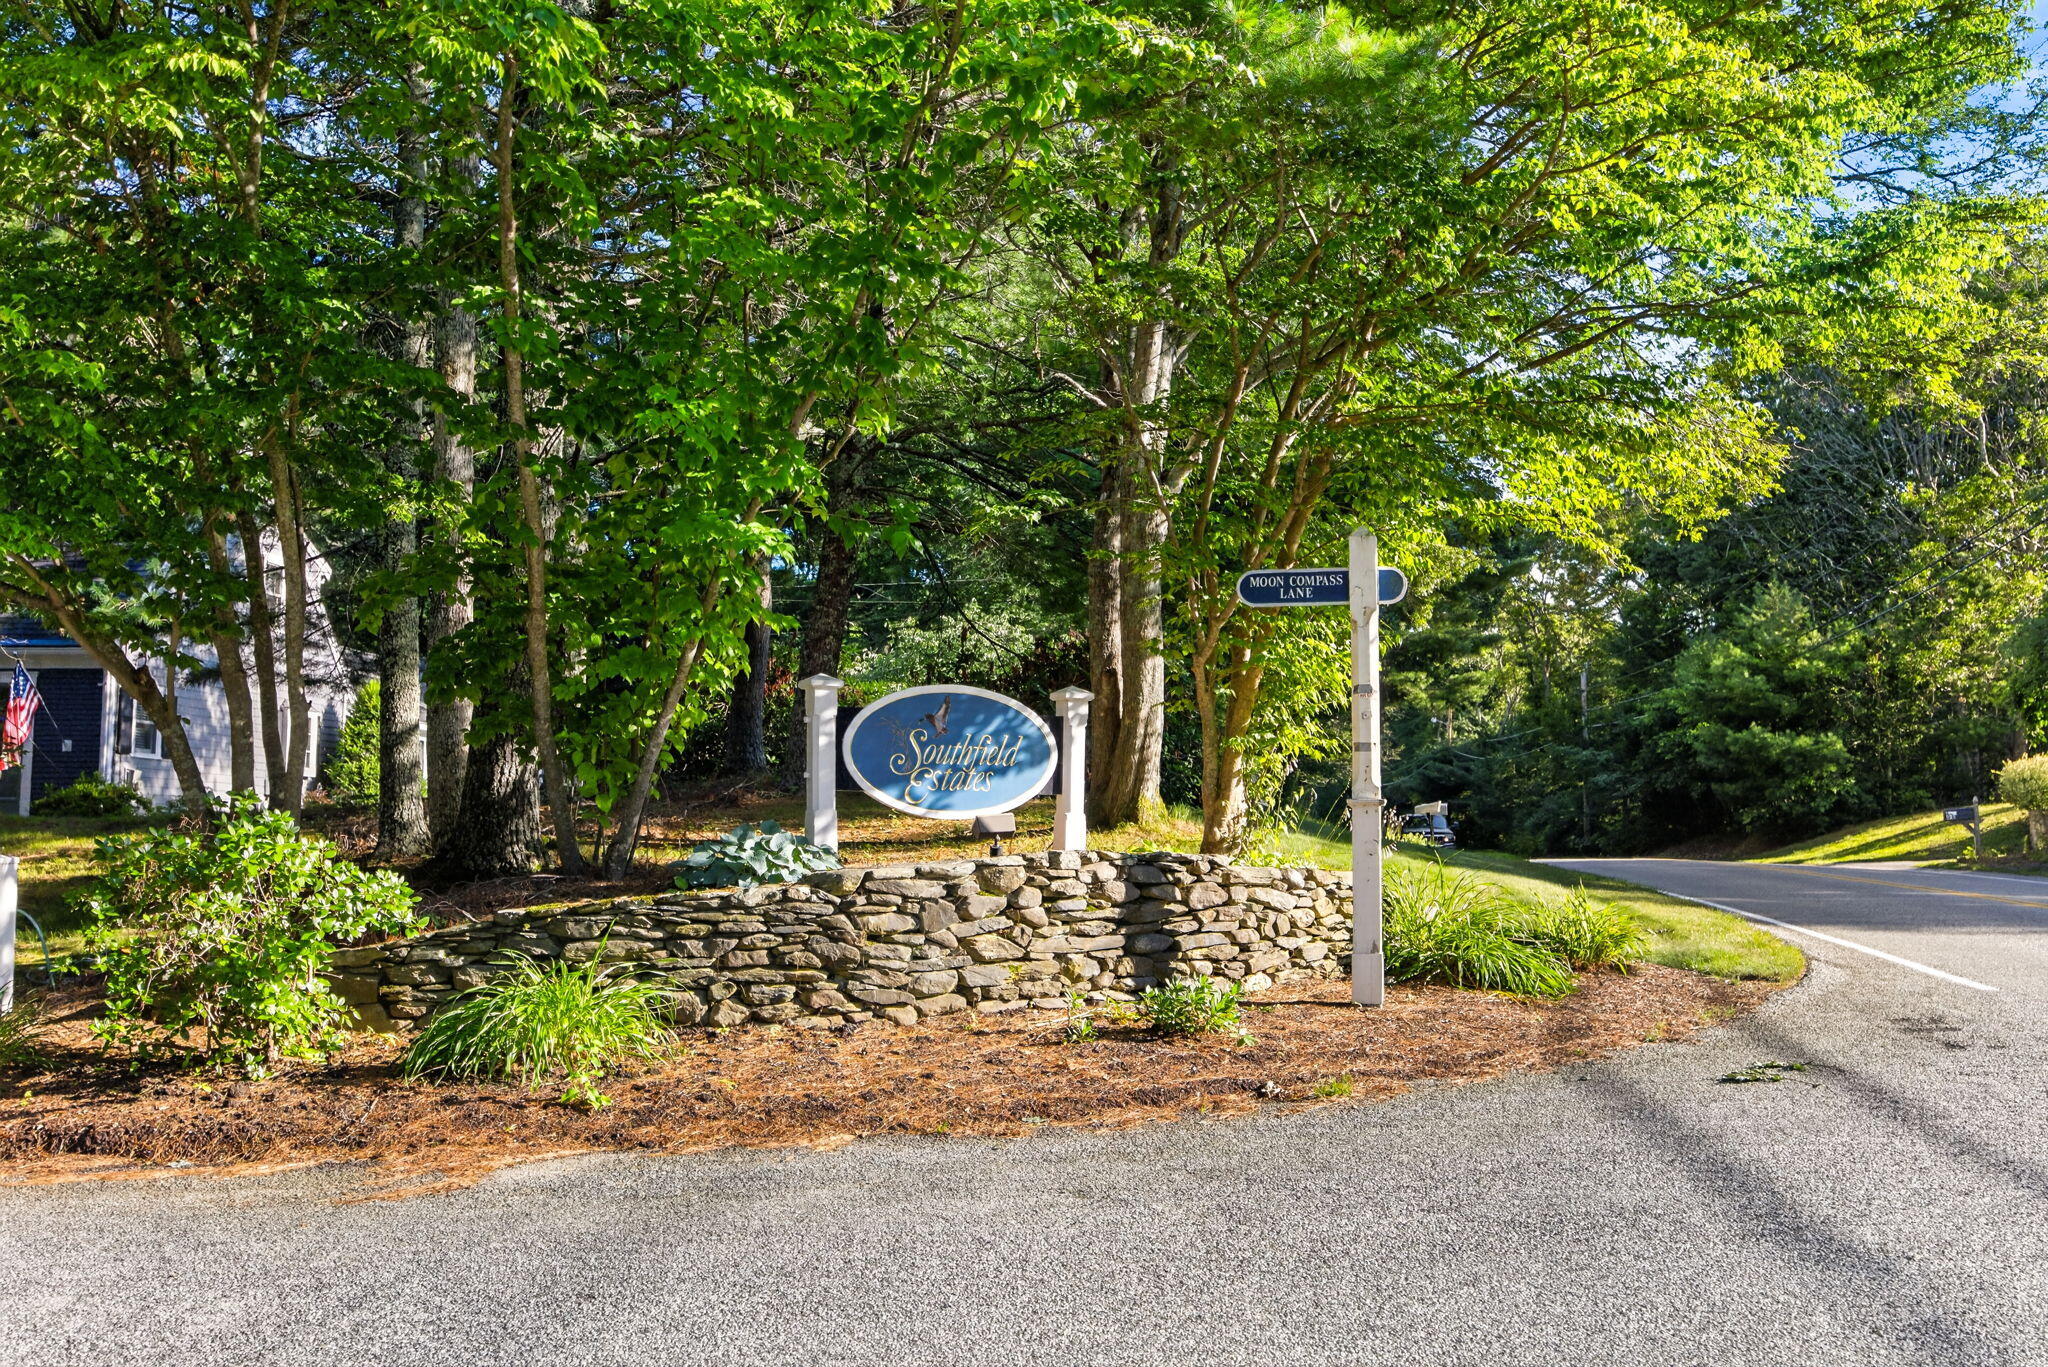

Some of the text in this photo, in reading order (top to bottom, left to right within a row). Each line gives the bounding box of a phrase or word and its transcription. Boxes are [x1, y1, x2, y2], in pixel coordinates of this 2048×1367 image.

[1250, 574, 1343, 588] MOON COMPASS
[1280, 587, 1313, 599] LANE
[890, 729, 1023, 775] Southfield
[905, 767, 994, 804] Estates
